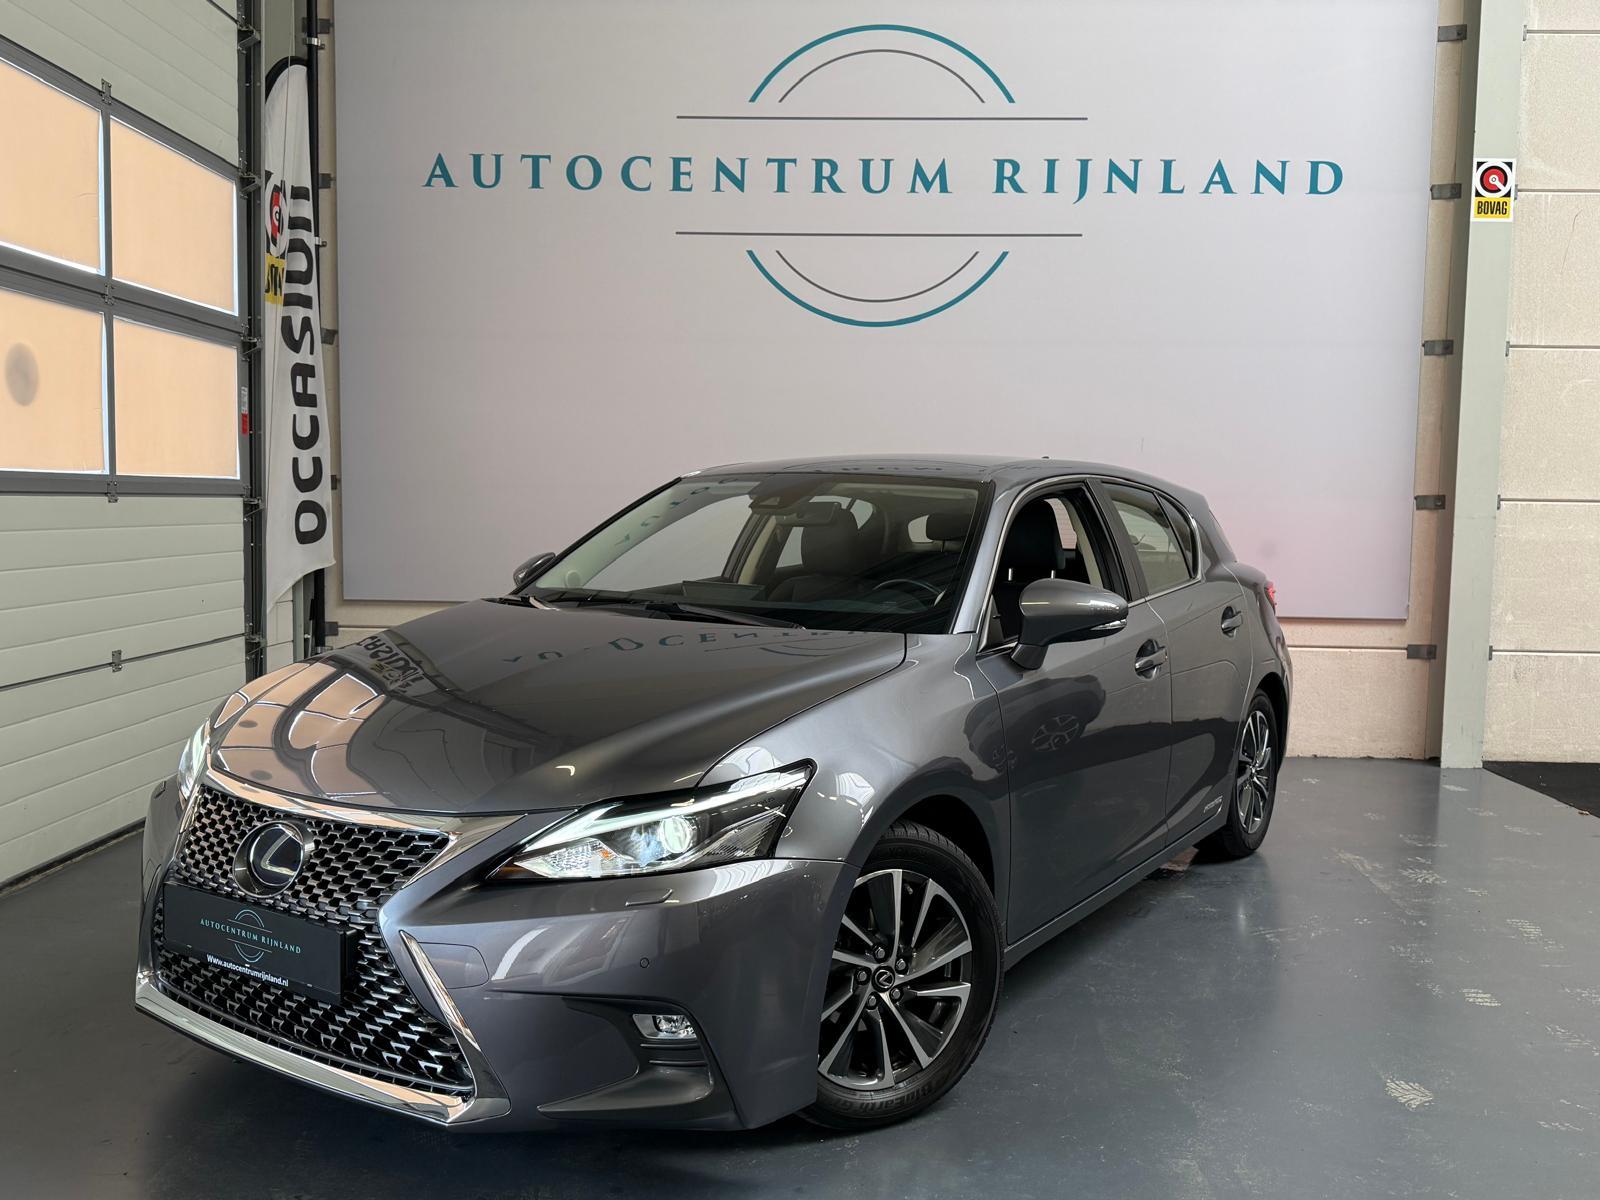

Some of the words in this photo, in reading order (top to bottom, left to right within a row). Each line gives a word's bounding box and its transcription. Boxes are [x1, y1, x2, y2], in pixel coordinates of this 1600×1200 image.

[421, 152, 953, 195] AUTOCENTRUM
[992, 157, 1344, 205] RIJNLAND
[1476, 200, 1508, 216] BOVAG
[200, 918, 258, 941] AUTOCENTRUM
[261, 935, 301, 954] RIJNLAND
[206, 953, 289, 987] Www.autocentrumrijnland.nl
